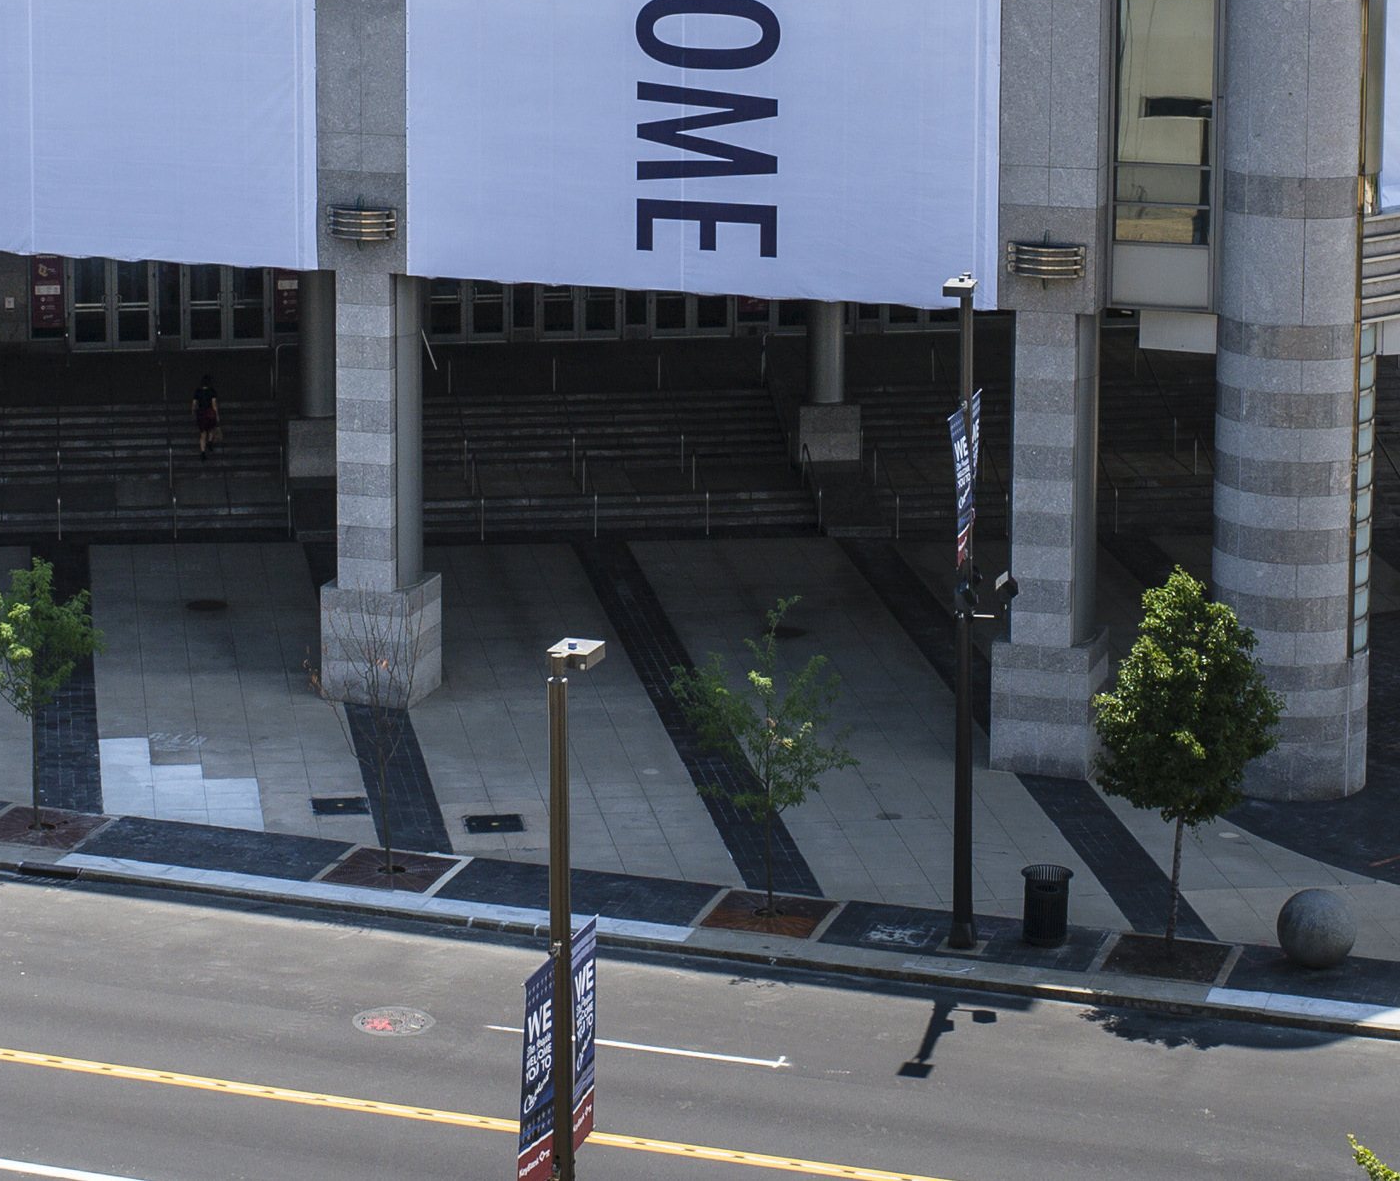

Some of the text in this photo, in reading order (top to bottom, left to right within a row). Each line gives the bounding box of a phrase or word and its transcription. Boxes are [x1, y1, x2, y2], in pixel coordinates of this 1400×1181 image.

[954, 435, 969, 461] WE
[575, 958, 594, 1003] WE
[528, 998, 552, 1044] WE
[586, 1012, 594, 1028] TO
[541, 1054, 552, 1072] TO
